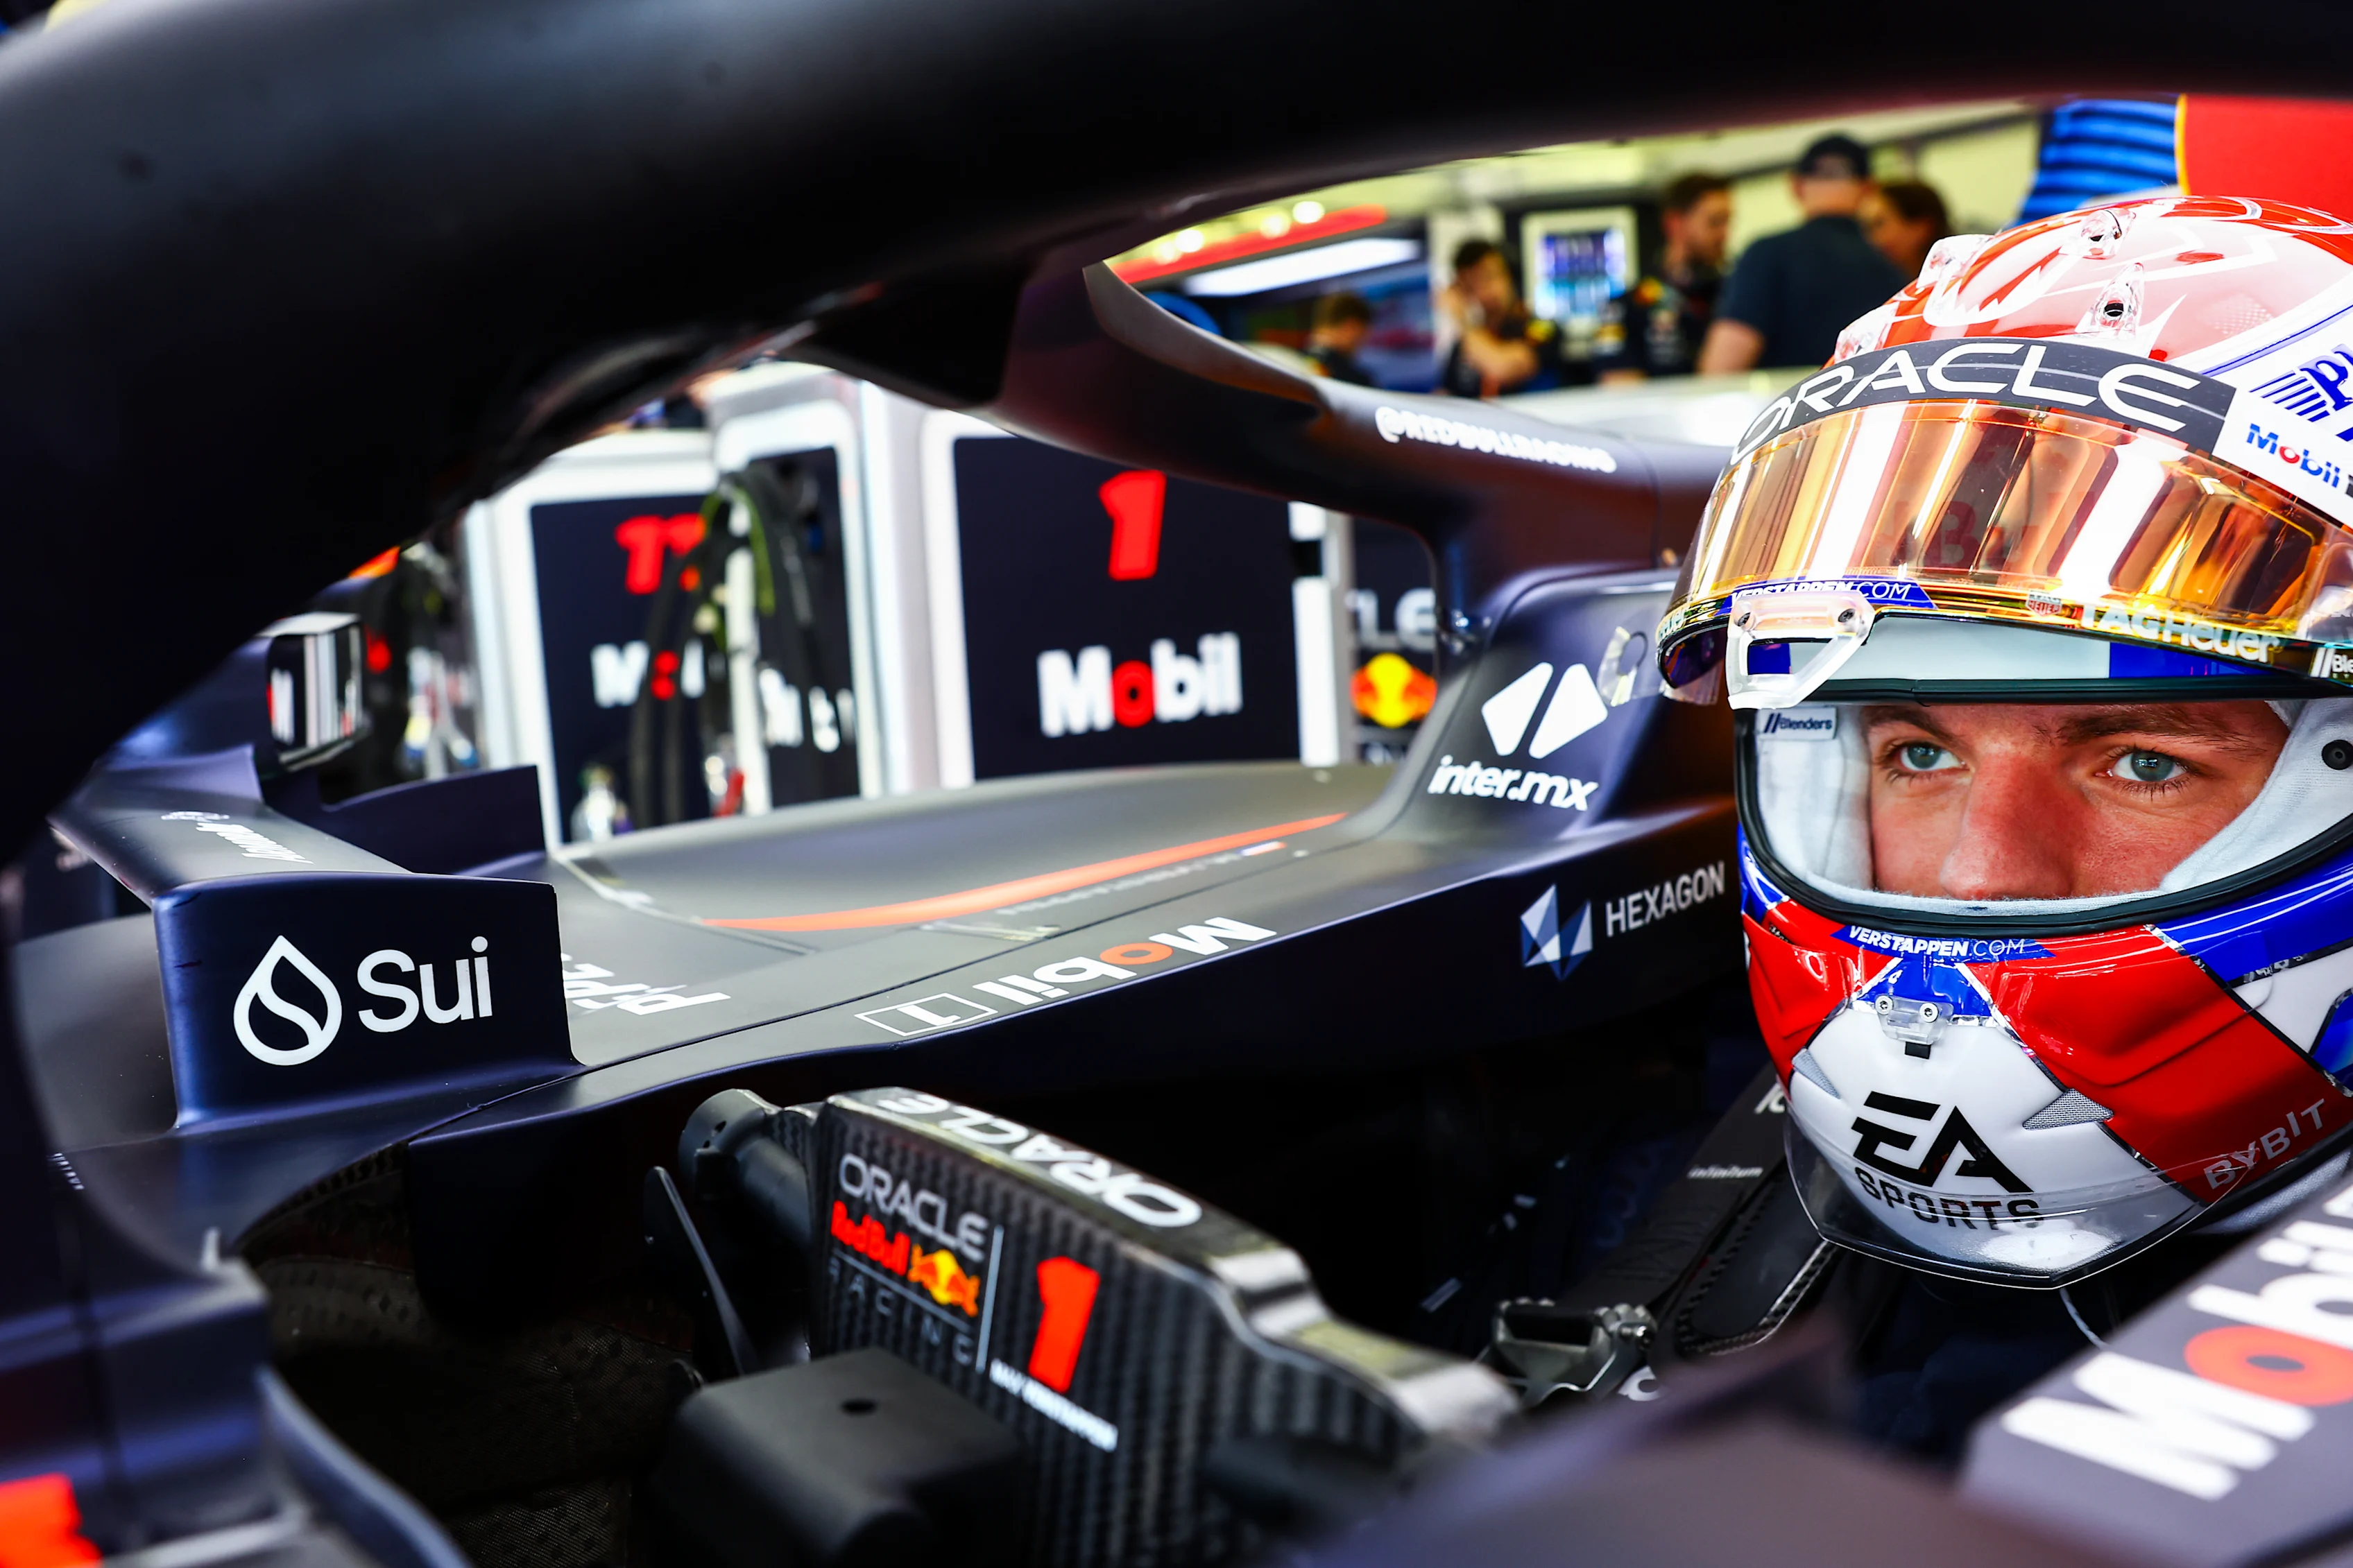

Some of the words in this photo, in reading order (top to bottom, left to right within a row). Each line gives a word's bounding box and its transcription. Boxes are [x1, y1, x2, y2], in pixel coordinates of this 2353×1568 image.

[1734, 343, 2200, 458] ORACLE
[1098, 469, 1167, 580] 1
[1036, 631, 1242, 737] Mobil
[2162, 613, 2281, 664] Heuer
[1428, 756, 1599, 811] inter.mx
[1605, 862, 1726, 938] HEXAGON
[1848, 925, 2026, 957] VERSTAPPEN.COM
[357, 936, 493, 1033] Sui
[973, 917, 1277, 1006] Mobil
[877, 1094, 1203, 1228] ORACLE
[1851, 1090, 2035, 1193] EA
[2204, 1099, 2326, 1192] BYBIT
[839, 1152, 989, 1264] ORACLE
[1855, 1166, 2044, 1231] SPORTS
[1027, 1256, 1100, 1393] 1
